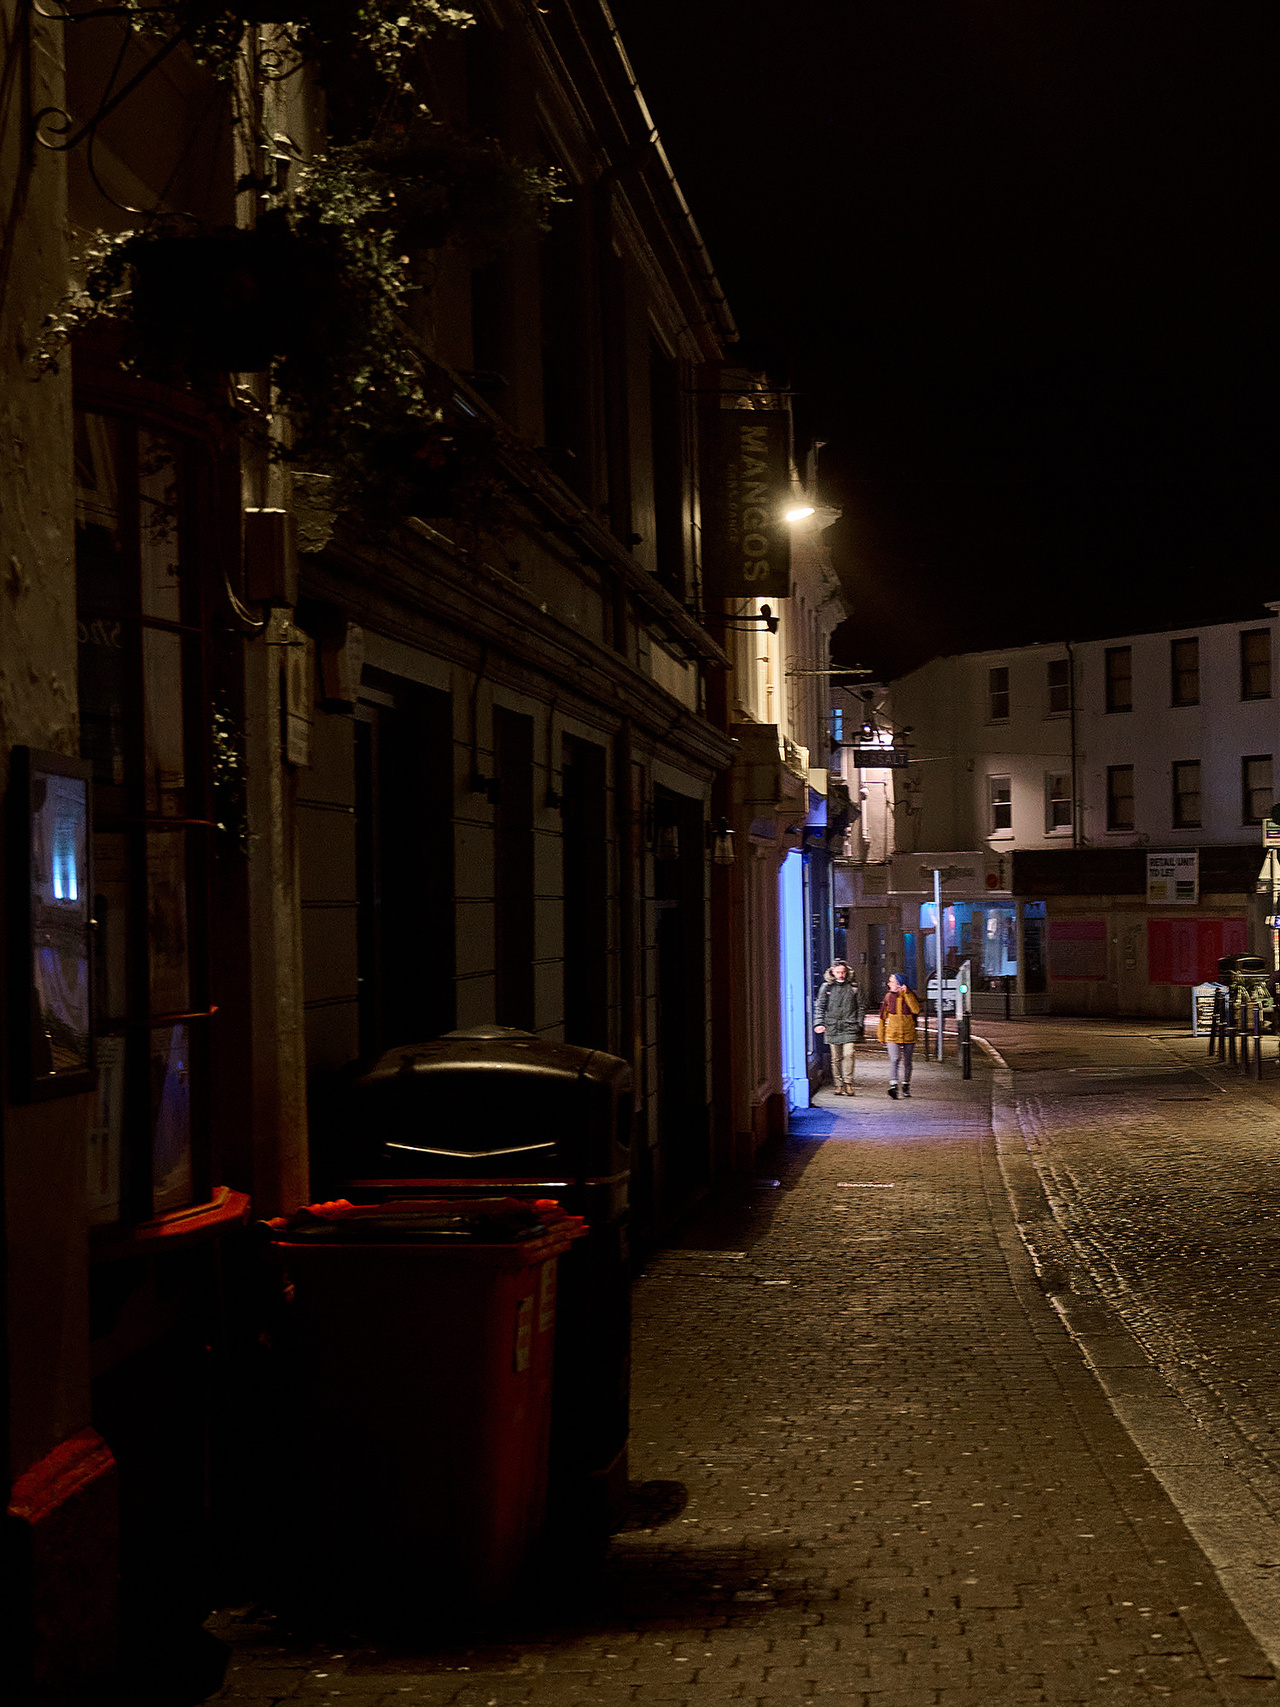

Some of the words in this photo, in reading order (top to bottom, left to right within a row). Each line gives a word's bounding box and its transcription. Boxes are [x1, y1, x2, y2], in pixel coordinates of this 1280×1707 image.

[740, 425, 770, 582] MANGOS
[855, 753, 908, 766] SEASALT
[1149, 857, 1175, 867] RETAIL
[1176, 857, 1195, 867] UNIT
[1149, 868, 1160, 878] TO
[1161, 868, 1174, 878] LET
